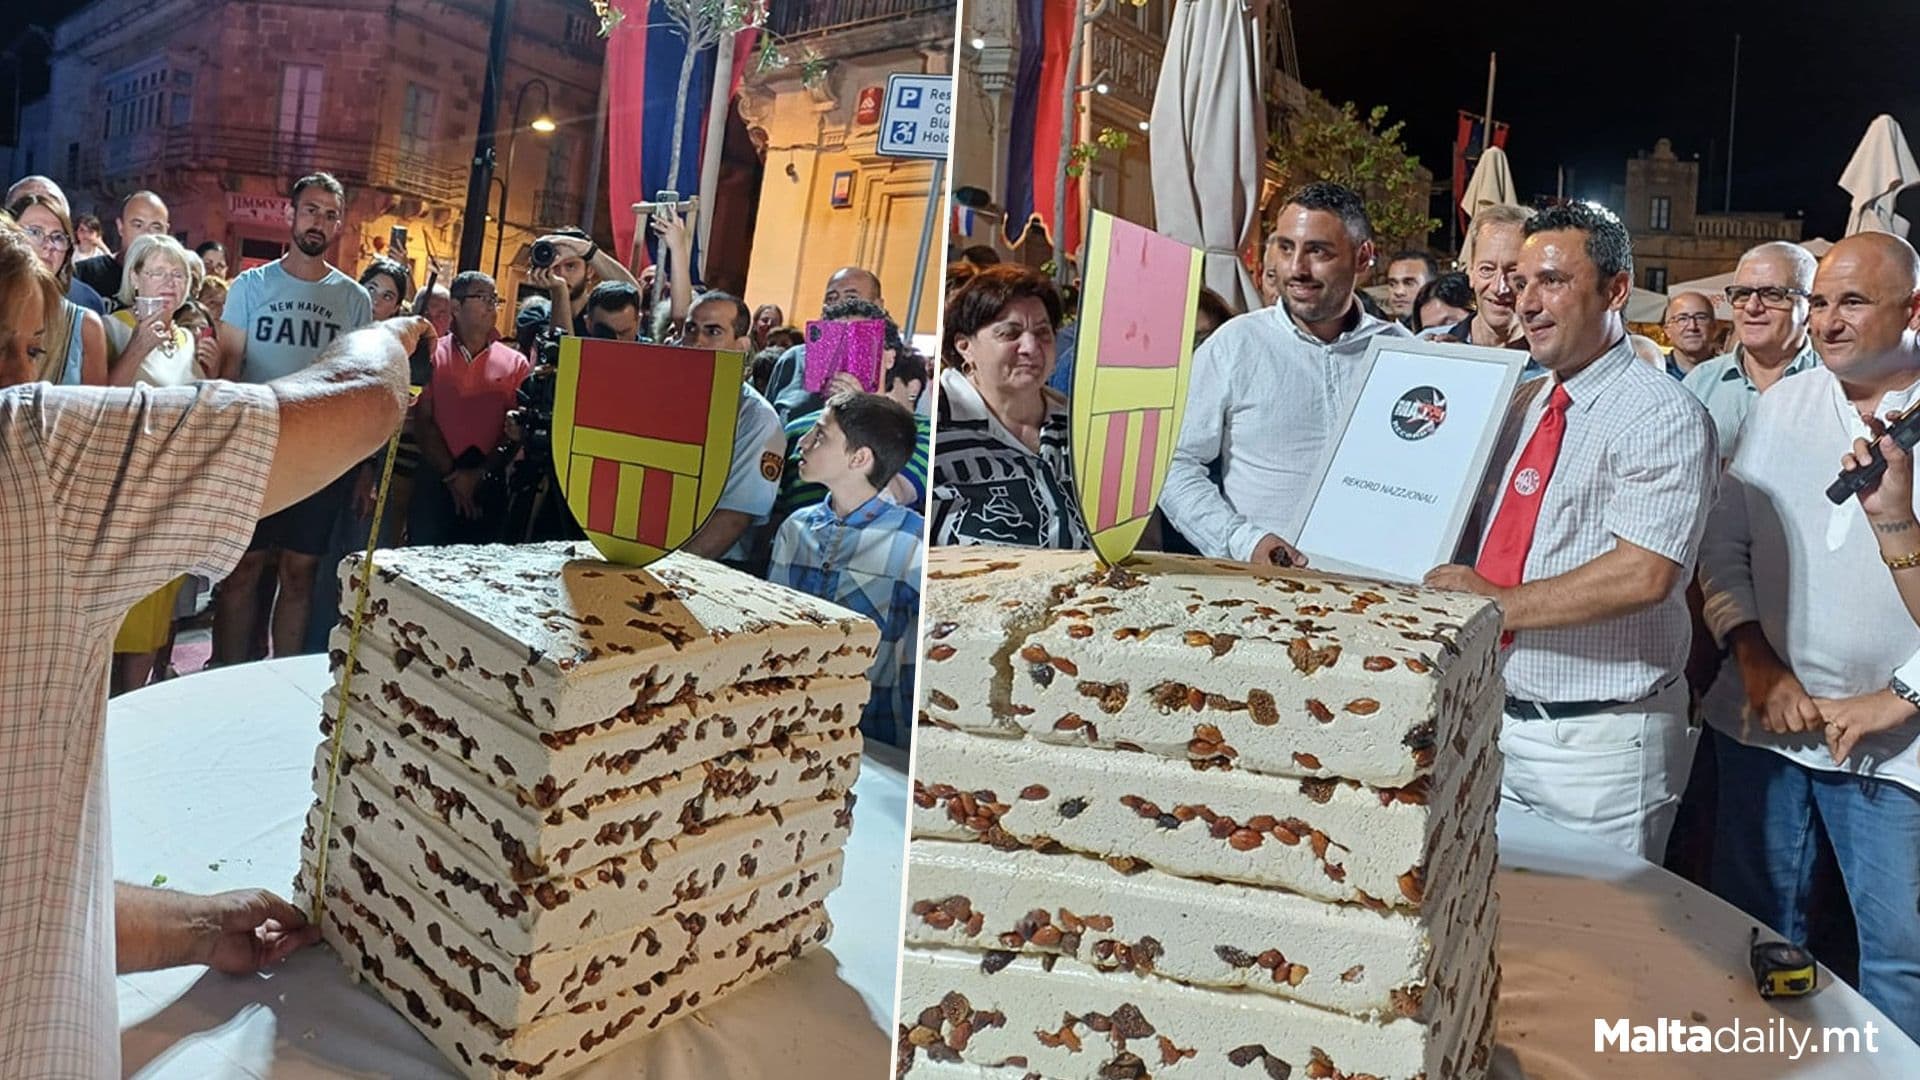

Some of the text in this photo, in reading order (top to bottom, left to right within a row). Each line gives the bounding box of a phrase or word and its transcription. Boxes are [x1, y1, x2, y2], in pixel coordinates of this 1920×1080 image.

[900, 89, 918, 106] P
[231, 196, 275, 212] JIMMY
[270, 301, 333, 319] NEW HAVEN
[255, 316, 341, 348] GANT
[1342, 476, 1439, 504] REKORD NAZZJONALI
